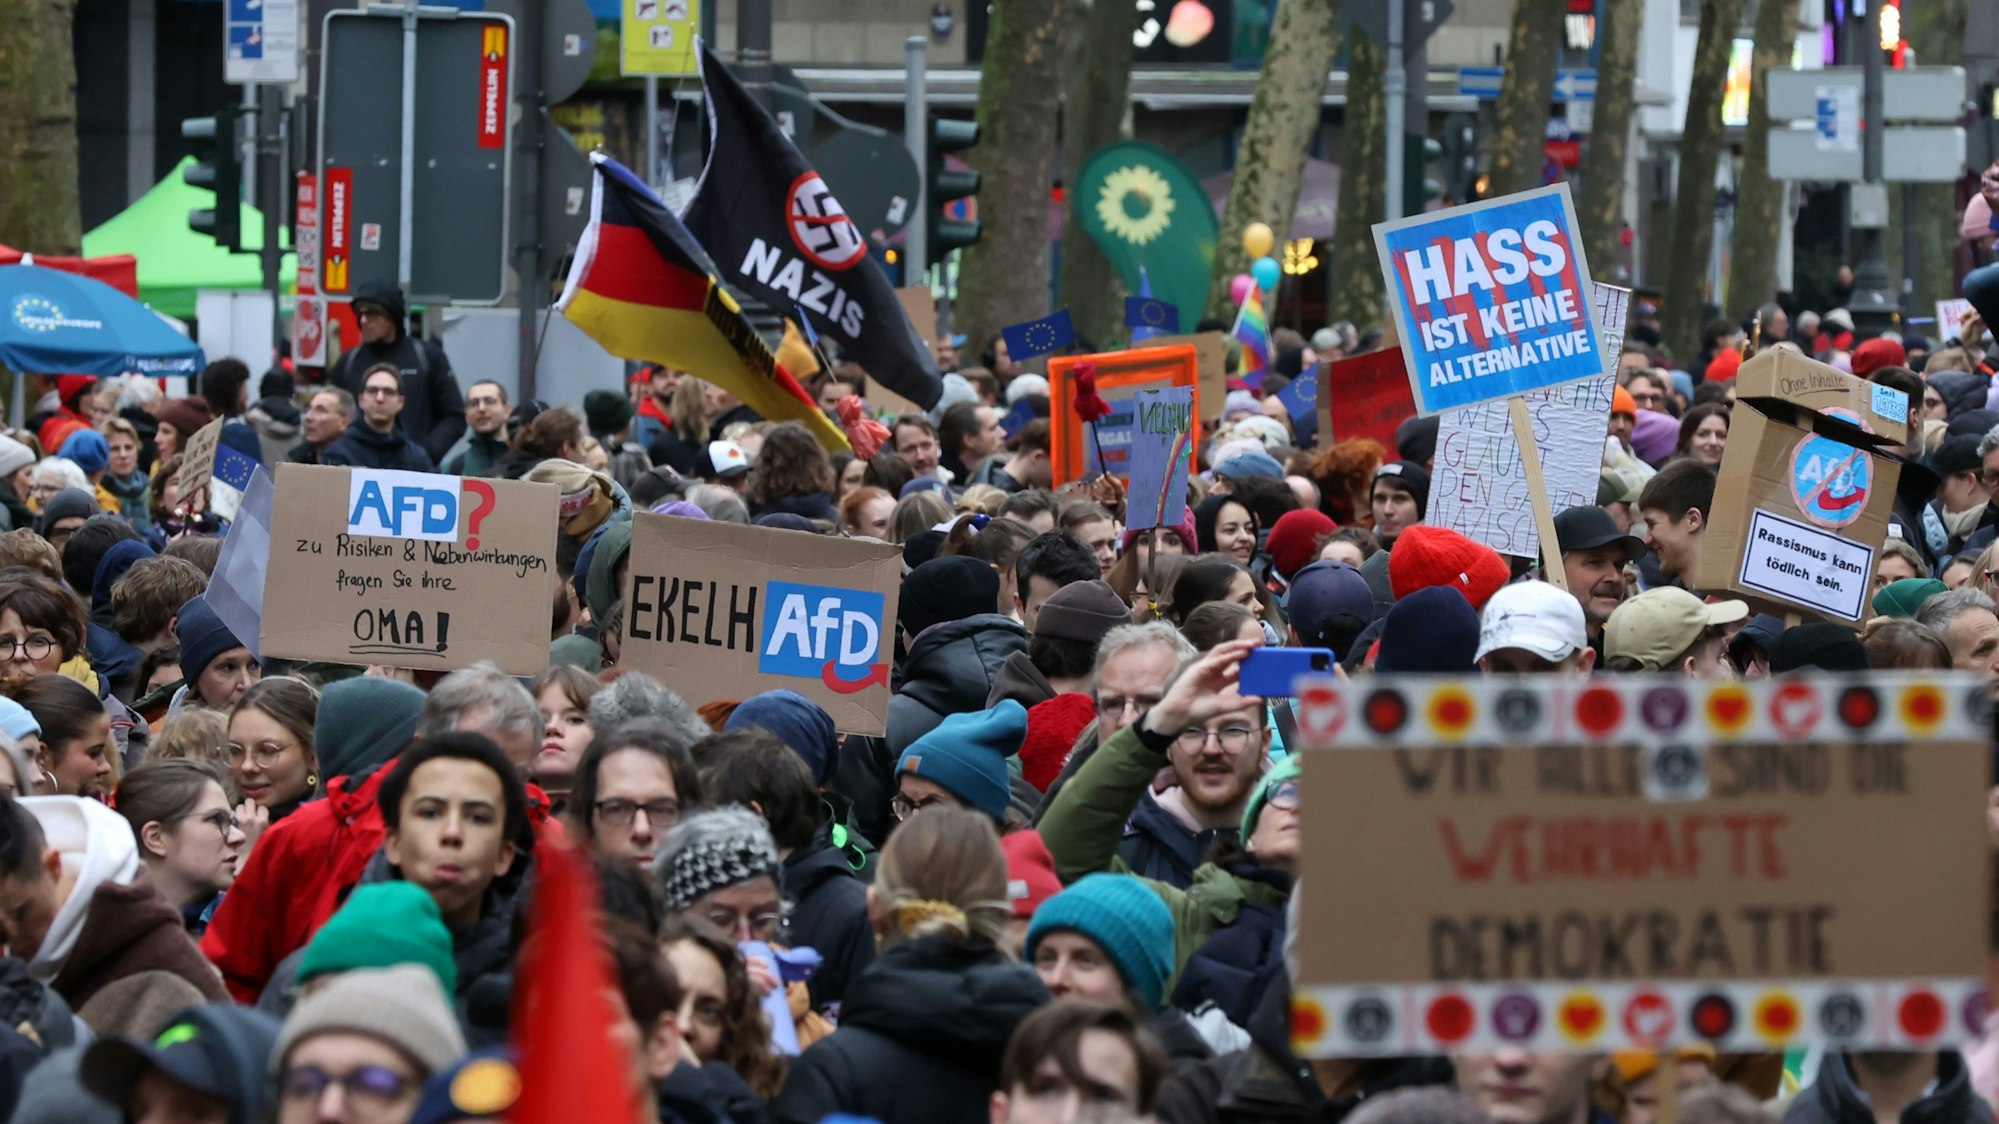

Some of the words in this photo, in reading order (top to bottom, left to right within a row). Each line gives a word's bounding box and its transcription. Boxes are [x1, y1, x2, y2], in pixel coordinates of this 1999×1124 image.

[485, 69, 498, 134] ZEPPELIN
[332, 182, 344, 248] ZEPPELIN
[1405, 220, 1566, 305] HASS
[740, 238, 864, 338] NAZIS
[1420, 313, 1468, 352] IST
[1479, 289, 1579, 338] KEINE
[1429, 329, 1591, 388] ALTERNATIVE
[1781, 377, 1808, 395] Ohne
[1809, 373, 1845, 389] Inhalte
[1875, 395, 1906, 421] 1933
[1880, 387, 1896, 398] Seit
[1439, 468, 1493, 506] DEN
[1799, 454, 1855, 492] AfD
[296, 539, 322, 554] zu
[336, 533, 393, 558] Risiken
[403, 539, 416, 562] &
[425, 541, 547, 577] Nebenwirkungen
[1758, 527, 1827, 562] Rassismus
[1832, 554, 1862, 575] kann
[336, 570, 382, 596] fragen
[393, 570, 412, 590] Sie
[422, 570, 457, 591] ihre
[1816, 574, 1844, 593] sein.
[353, 608, 450, 653] OMA!
[1391, 745, 1501, 795] WIR
[1712, 743, 1832, 797] SIND
[1850, 743, 1910, 796] DIE
[1437, 813, 1789, 884] WEHRHAFTE
[1428, 905, 1838, 982] DEMOKRATIE
